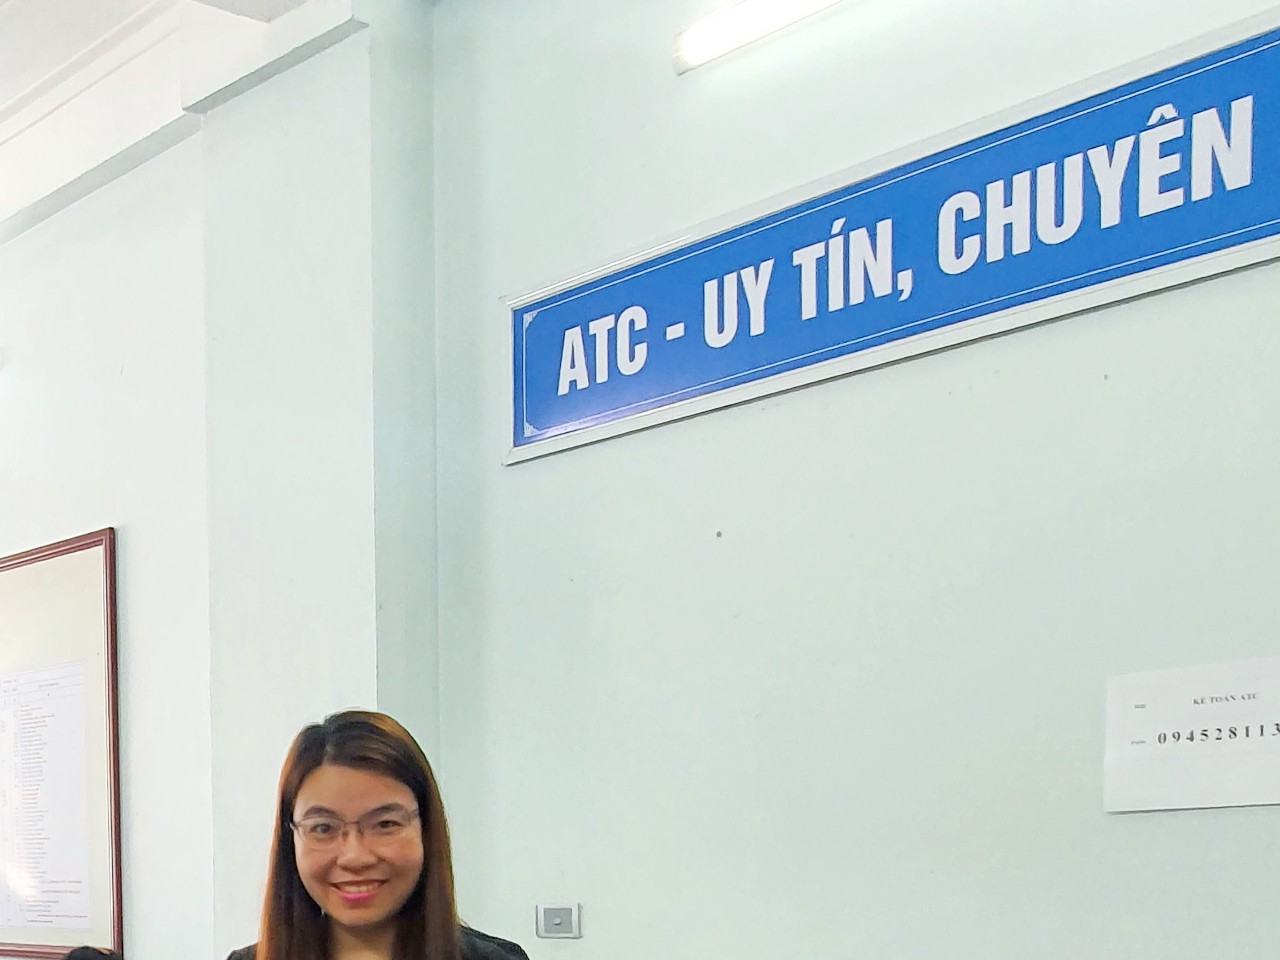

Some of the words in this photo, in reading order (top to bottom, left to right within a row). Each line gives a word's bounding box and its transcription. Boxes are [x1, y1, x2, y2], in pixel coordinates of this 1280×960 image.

[557, 306, 648, 396] ATC
[666, 320, 685, 343] -
[703, 257, 773, 350] UY
[792, 217, 914, 320] TÍN,
[937, 95, 1255, 276] CHUYÊN
